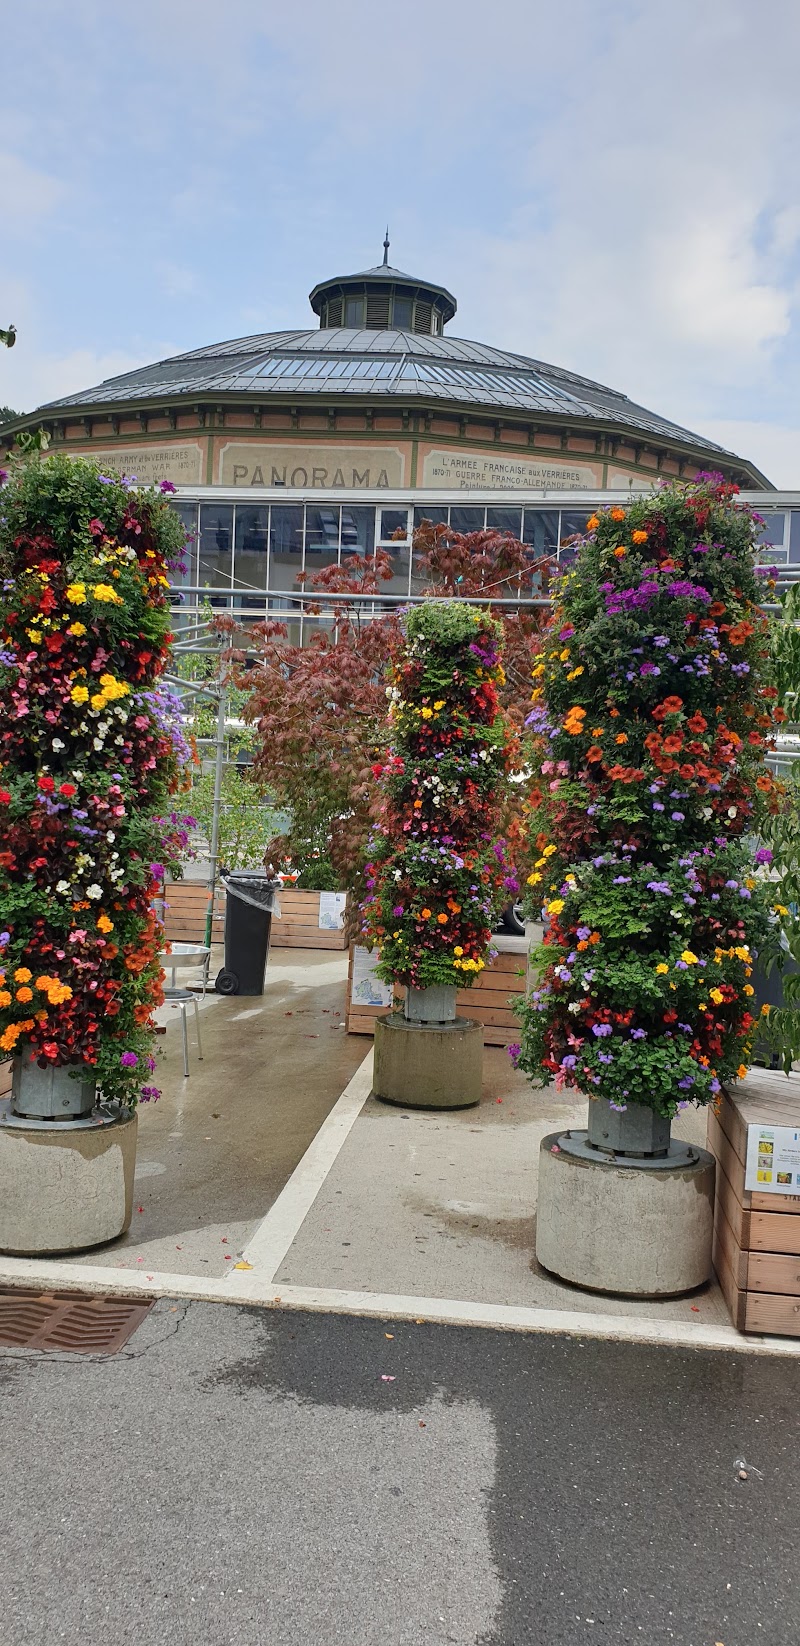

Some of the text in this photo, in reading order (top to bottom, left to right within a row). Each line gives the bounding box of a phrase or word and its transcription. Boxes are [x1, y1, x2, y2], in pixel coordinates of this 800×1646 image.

[119, 455, 138, 463] ARMY
[152, 463, 171, 471] WAR
[232, 464, 389, 488] PANORAMA
[528, 469, 540, 477] aux
[455, 470, 487, 481] GUERRE
[491, 474, 566, 489] FRANCO-ALLEMANDE
